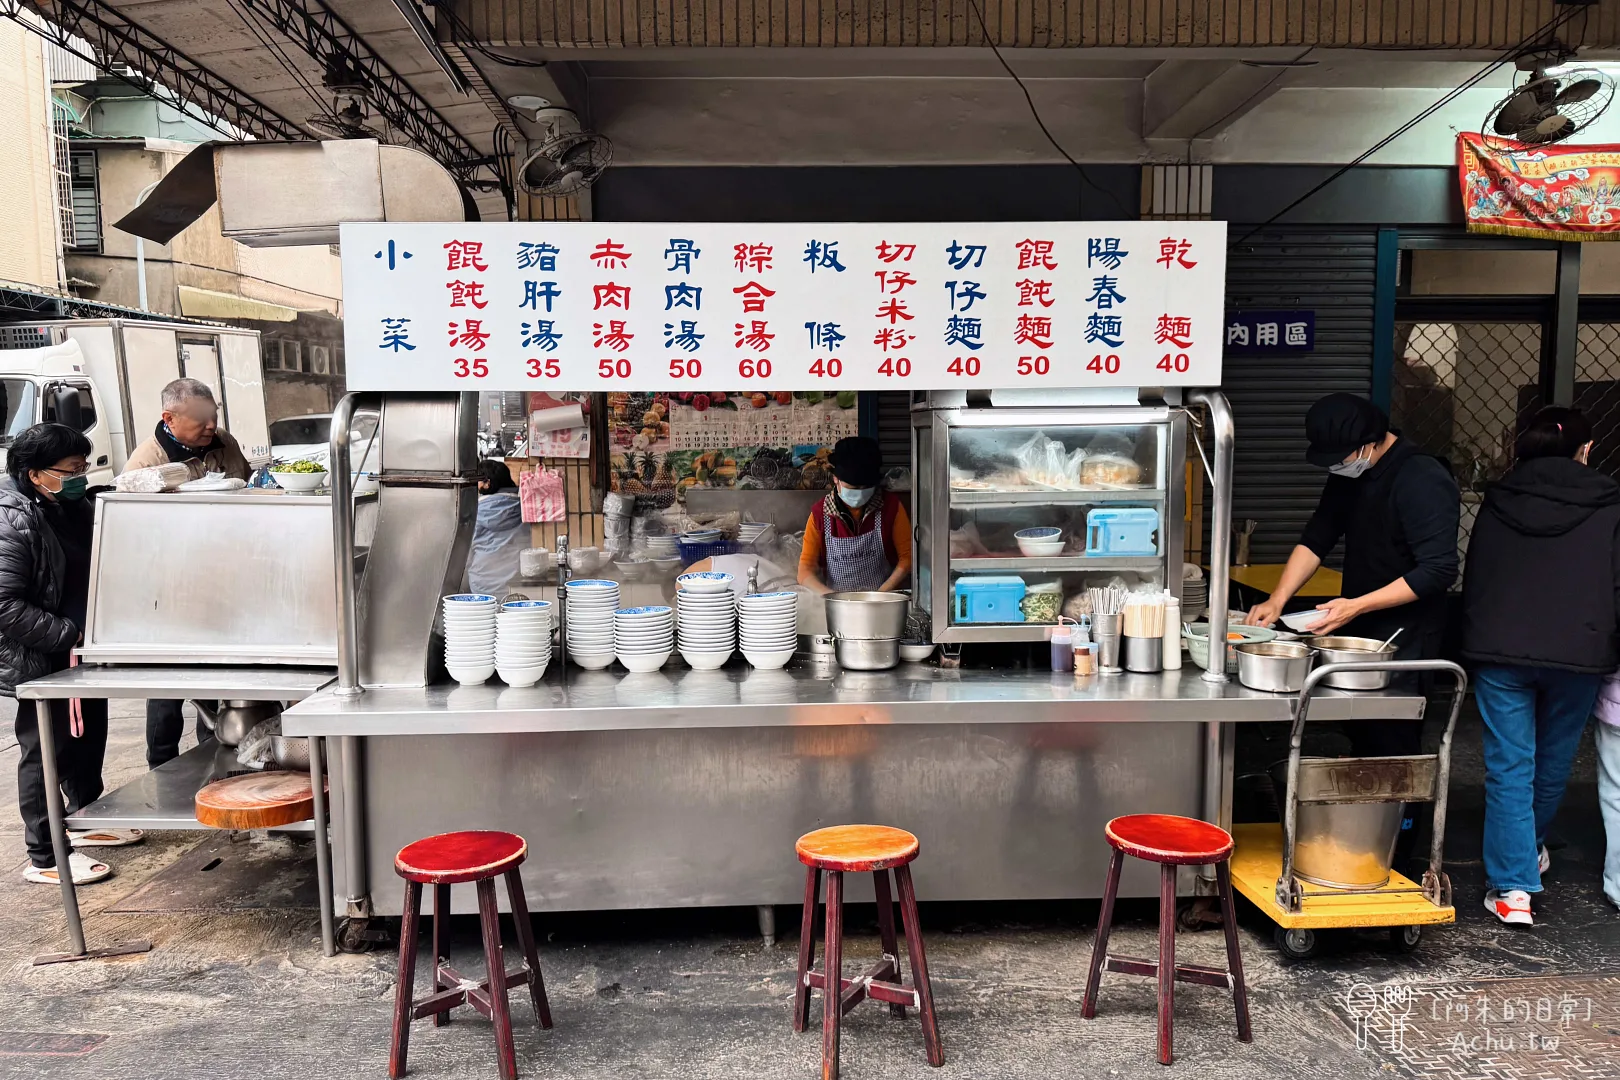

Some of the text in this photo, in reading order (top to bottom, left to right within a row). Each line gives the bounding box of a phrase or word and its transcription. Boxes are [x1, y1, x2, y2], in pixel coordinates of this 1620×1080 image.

[376, 240, 416, 352] 小菜
[443, 240, 491, 352] 餛飩湯
[517, 242, 563, 352] 豬肝湯
[590, 239, 635, 352] 赤肉湯
[664, 239, 706, 352] 骨肉湯
[733, 242, 777, 352] 綜合湯
[873, 241, 917, 352] 切仔米粉
[944, 240, 988, 350] 切仔麵
[1013, 238, 1058, 349] 餛飩麵
[1084, 238, 1129, 349] 陽春麵
[1227, 322, 1307, 345] 內用區
[453, 358, 489, 378] 35
[526, 358, 561, 378] 35
[598, 359, 632, 378] 50
[669, 359, 702, 378] 50
[738, 359, 772, 378] 60
[808, 358, 843, 377] 40
[877, 358, 912, 377] 40
[946, 357, 981, 376] 40
[1017, 356, 1051, 375] 50
[1086, 355, 1121, 374] 40
[1156, 354, 1190, 373] 40
